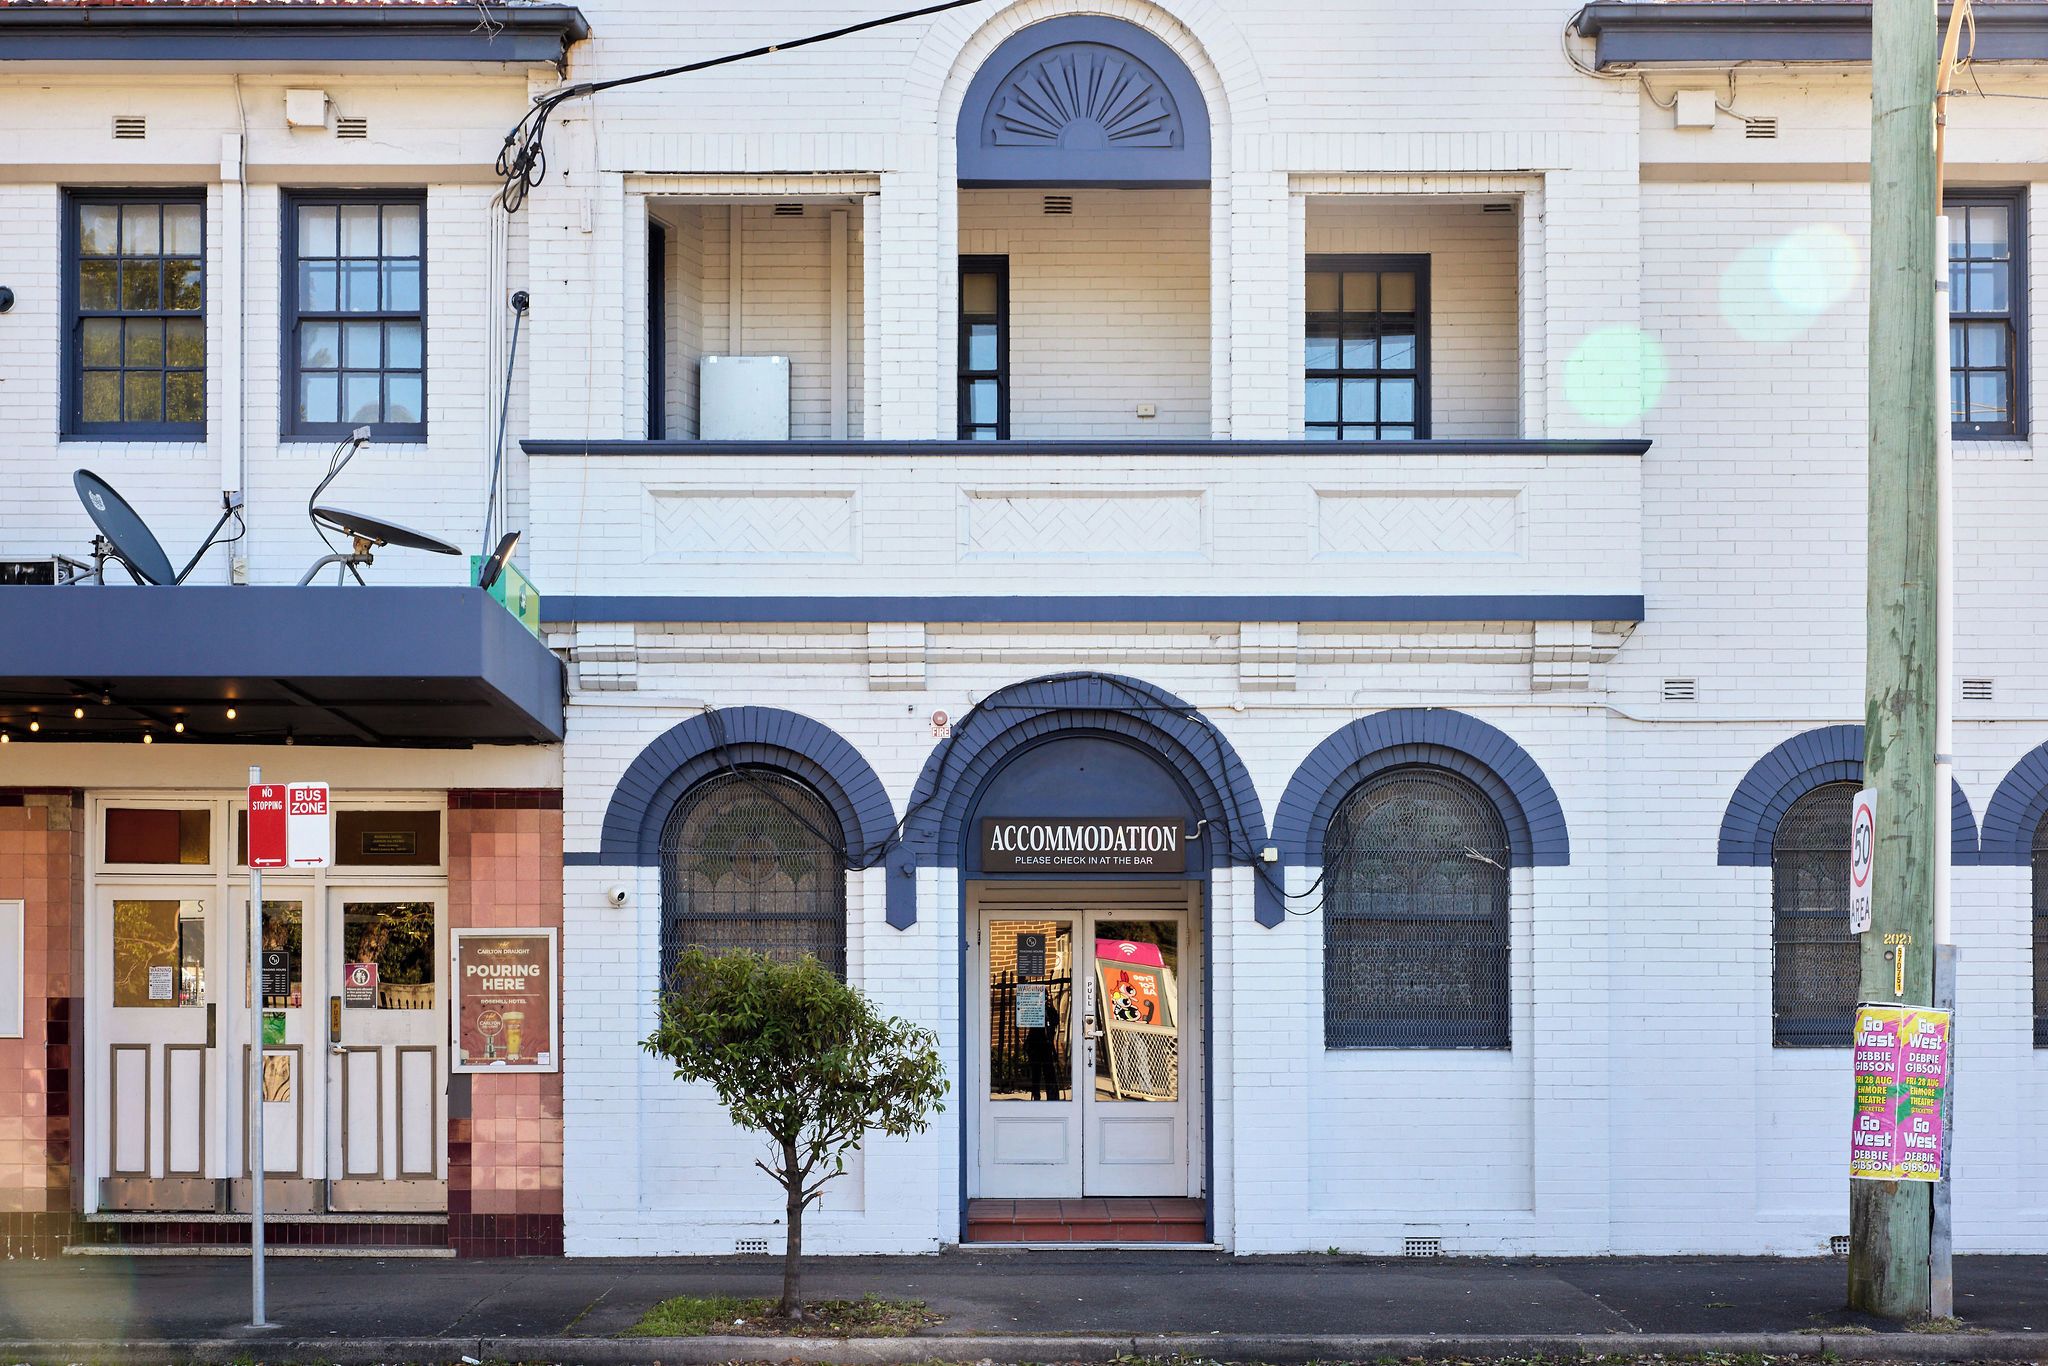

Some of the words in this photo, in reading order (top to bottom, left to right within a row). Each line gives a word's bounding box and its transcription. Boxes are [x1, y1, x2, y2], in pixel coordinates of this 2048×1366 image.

[933, 728, 949, 737] FIRE
[262, 788, 272, 797] NO
[295, 790, 321, 801] BUS
[252, 801, 283, 810] STOPPING
[291, 802, 326, 814] ZONE
[990, 825, 1177, 851] ACCOMMODATION
[1855, 825, 1870, 867] 50
[1015, 856, 1051, 865] PLEASE
[1053, 856, 1086, 865] CHECK
[1088, 856, 1098, 865] IN
[1099, 856, 1111, 865] AT
[1113, 856, 1131, 865] THE
[1134, 856, 1153, 865] BAR
[1851, 897, 1870, 921] AREA
[1883, 933, 1912, 945] 2021
[466, 965, 540, 977] POURING
[482, 978, 525, 990] HERE
[1863, 1016, 1883, 1032] Go
[1919, 1018, 1936, 1034] Go
[1857, 1032, 1895, 1047] West
[1909, 1034, 1942, 1050] West
[1857, 1051, 1891, 1061] DEBBIE
[1856, 1062, 1895, 1072] GIBSON
[1905, 1063, 1941, 1074] GIBSON
[1856, 1075, 1864, 1084] FRI
[1865, 1076, 1874, 1084] 28
[1875, 1076, 1892, 1085] AUG
[1906, 1076, 1916, 1085] FRI
[1917, 1078, 1926, 1086] 28
[1927, 1079, 1939, 1087] AUG
[1858, 1085, 1887, 1094] ENMORE
[1910, 1087, 1935, 1096] ENMORE
[1858, 1096, 1887, 1104] THEATRE
[1910, 1097, 1935, 1106] THEATRE
[1860, 1116, 1880, 1131] Go
[1913, 1117, 1930, 1133] Go
[1854, 1131, 1892, 1147] West
[1903, 1132, 1937, 1149] West
[1854, 1150, 1888, 1160] DEBBIE
[1905, 1151, 1934, 1162] DEBBIE
[1852, 1160, 1892, 1171] GIBSON
[1901, 1162, 1936, 1173] GIBSON
